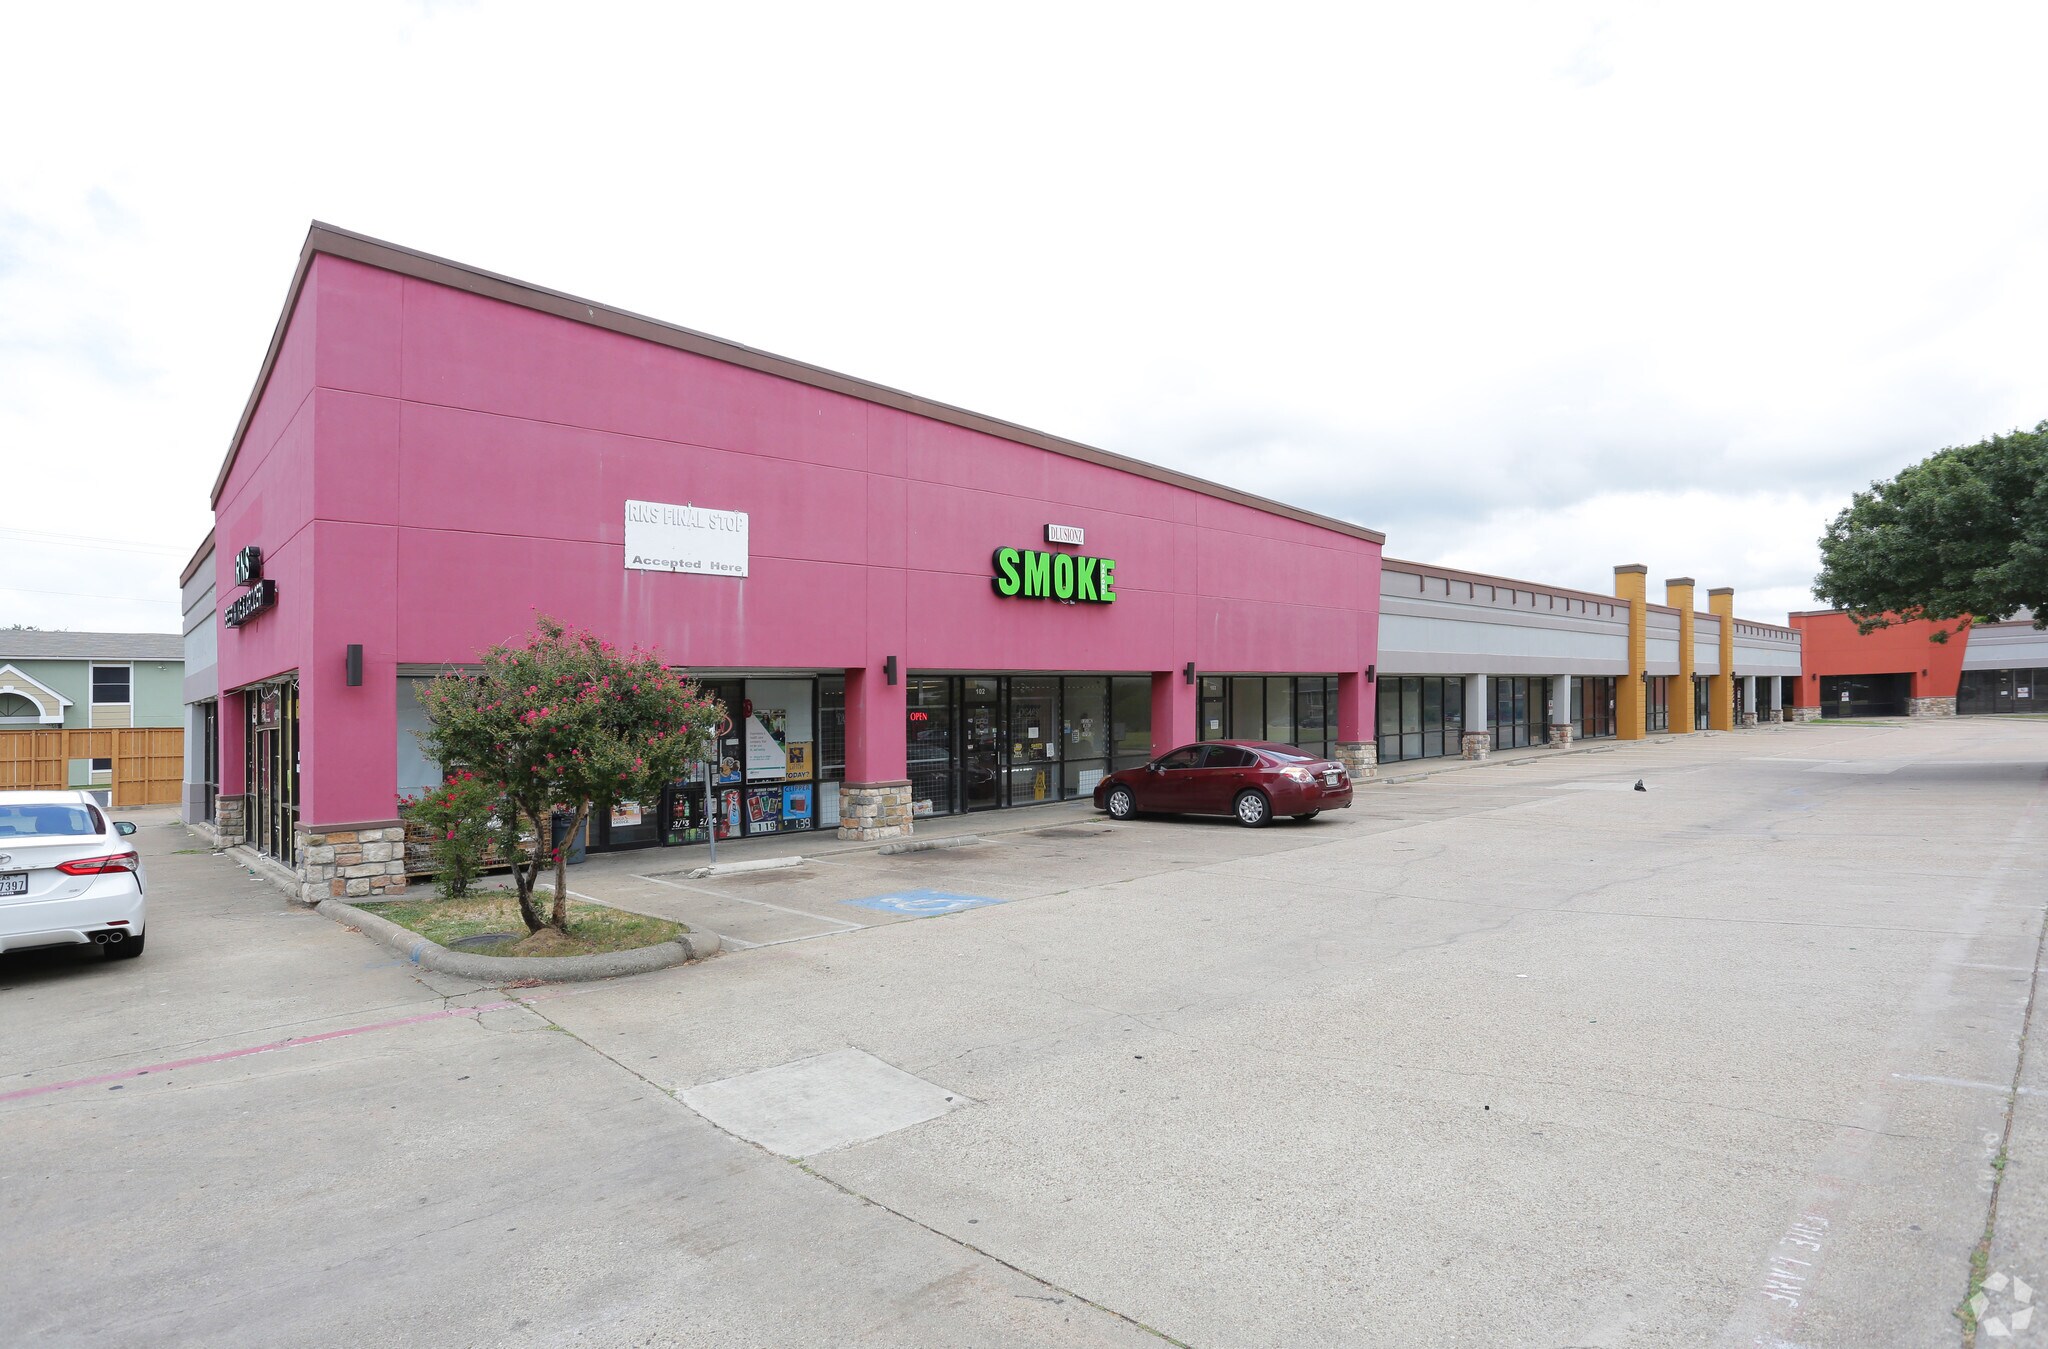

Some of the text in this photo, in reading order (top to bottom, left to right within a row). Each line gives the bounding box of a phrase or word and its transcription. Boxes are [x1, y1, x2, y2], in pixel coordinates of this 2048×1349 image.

[628, 504, 745, 532] RNS FINAL STOP
[632, 555, 743, 572] Accepted Here
[998, 547, 1117, 602] SMOKE
[909, 712, 928, 721] OPEN
[784, 784, 811, 792] CLIPPER
